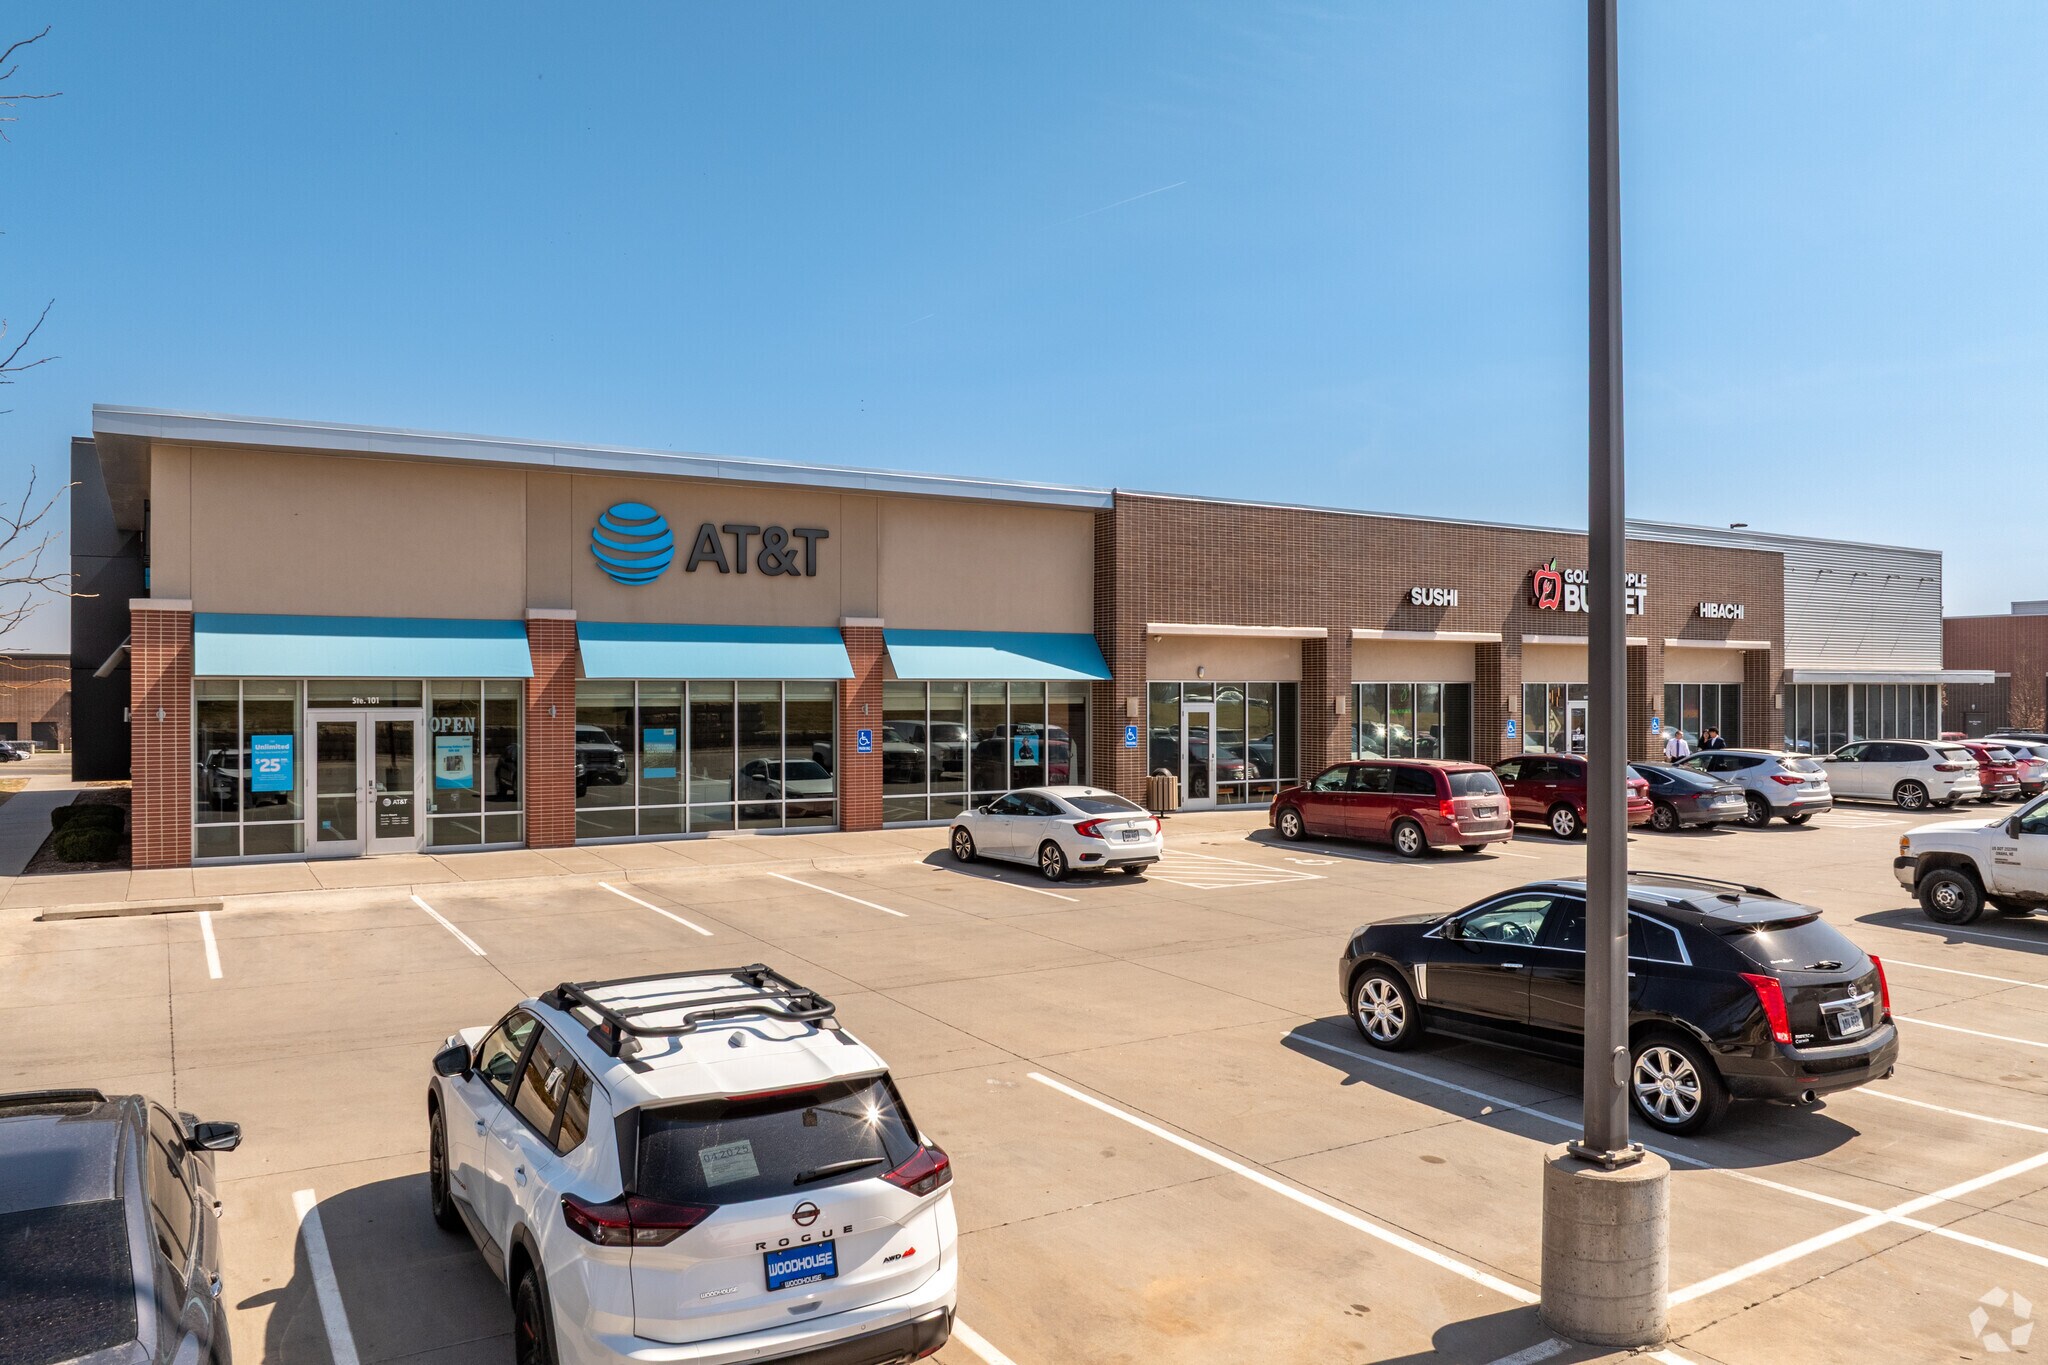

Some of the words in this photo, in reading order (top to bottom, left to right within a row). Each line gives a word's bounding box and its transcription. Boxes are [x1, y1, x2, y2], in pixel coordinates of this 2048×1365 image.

[685, 523, 829, 577] AT&T
[1411, 586, 1459, 607] SUSHI
[1700, 602, 1744, 620] HIBACHI
[352, 696, 366, 705] Ste.
[367, 696, 380, 705] 101
[429, 716, 476, 733] OPEN
[254, 743, 290, 751] Unlimited
[255, 757, 282, 773] $25
[755, 1224, 853, 1251] ROGUE
[768, 1251, 833, 1277] WOODHOUSE
[882, 1253, 902, 1265] AWD
[784, 1273, 823, 1289] WOODHOUSE
